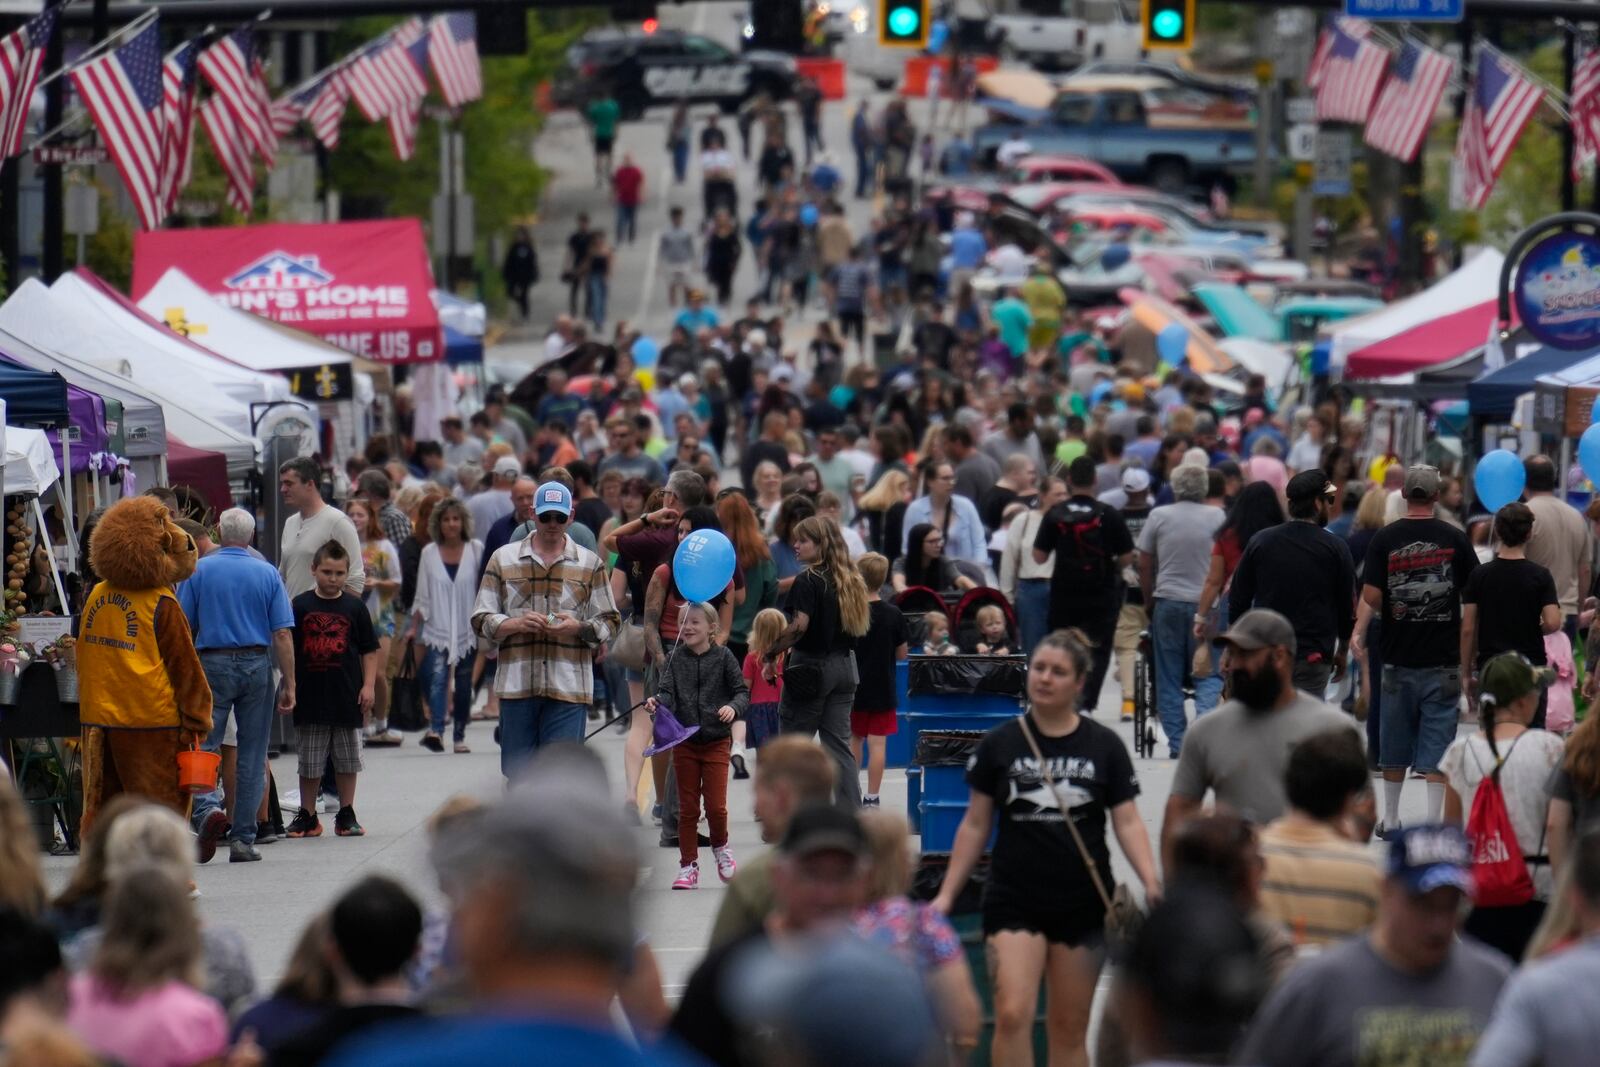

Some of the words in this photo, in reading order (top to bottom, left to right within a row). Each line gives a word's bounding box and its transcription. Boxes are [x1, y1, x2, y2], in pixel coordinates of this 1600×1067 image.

[642, 65, 752, 97] POLICE
[305, 286, 408, 306] HOME
[279, 308, 303, 321] ALL
[107, 591, 132, 611] LIONS
[125, 610, 139, 637] CLUB
